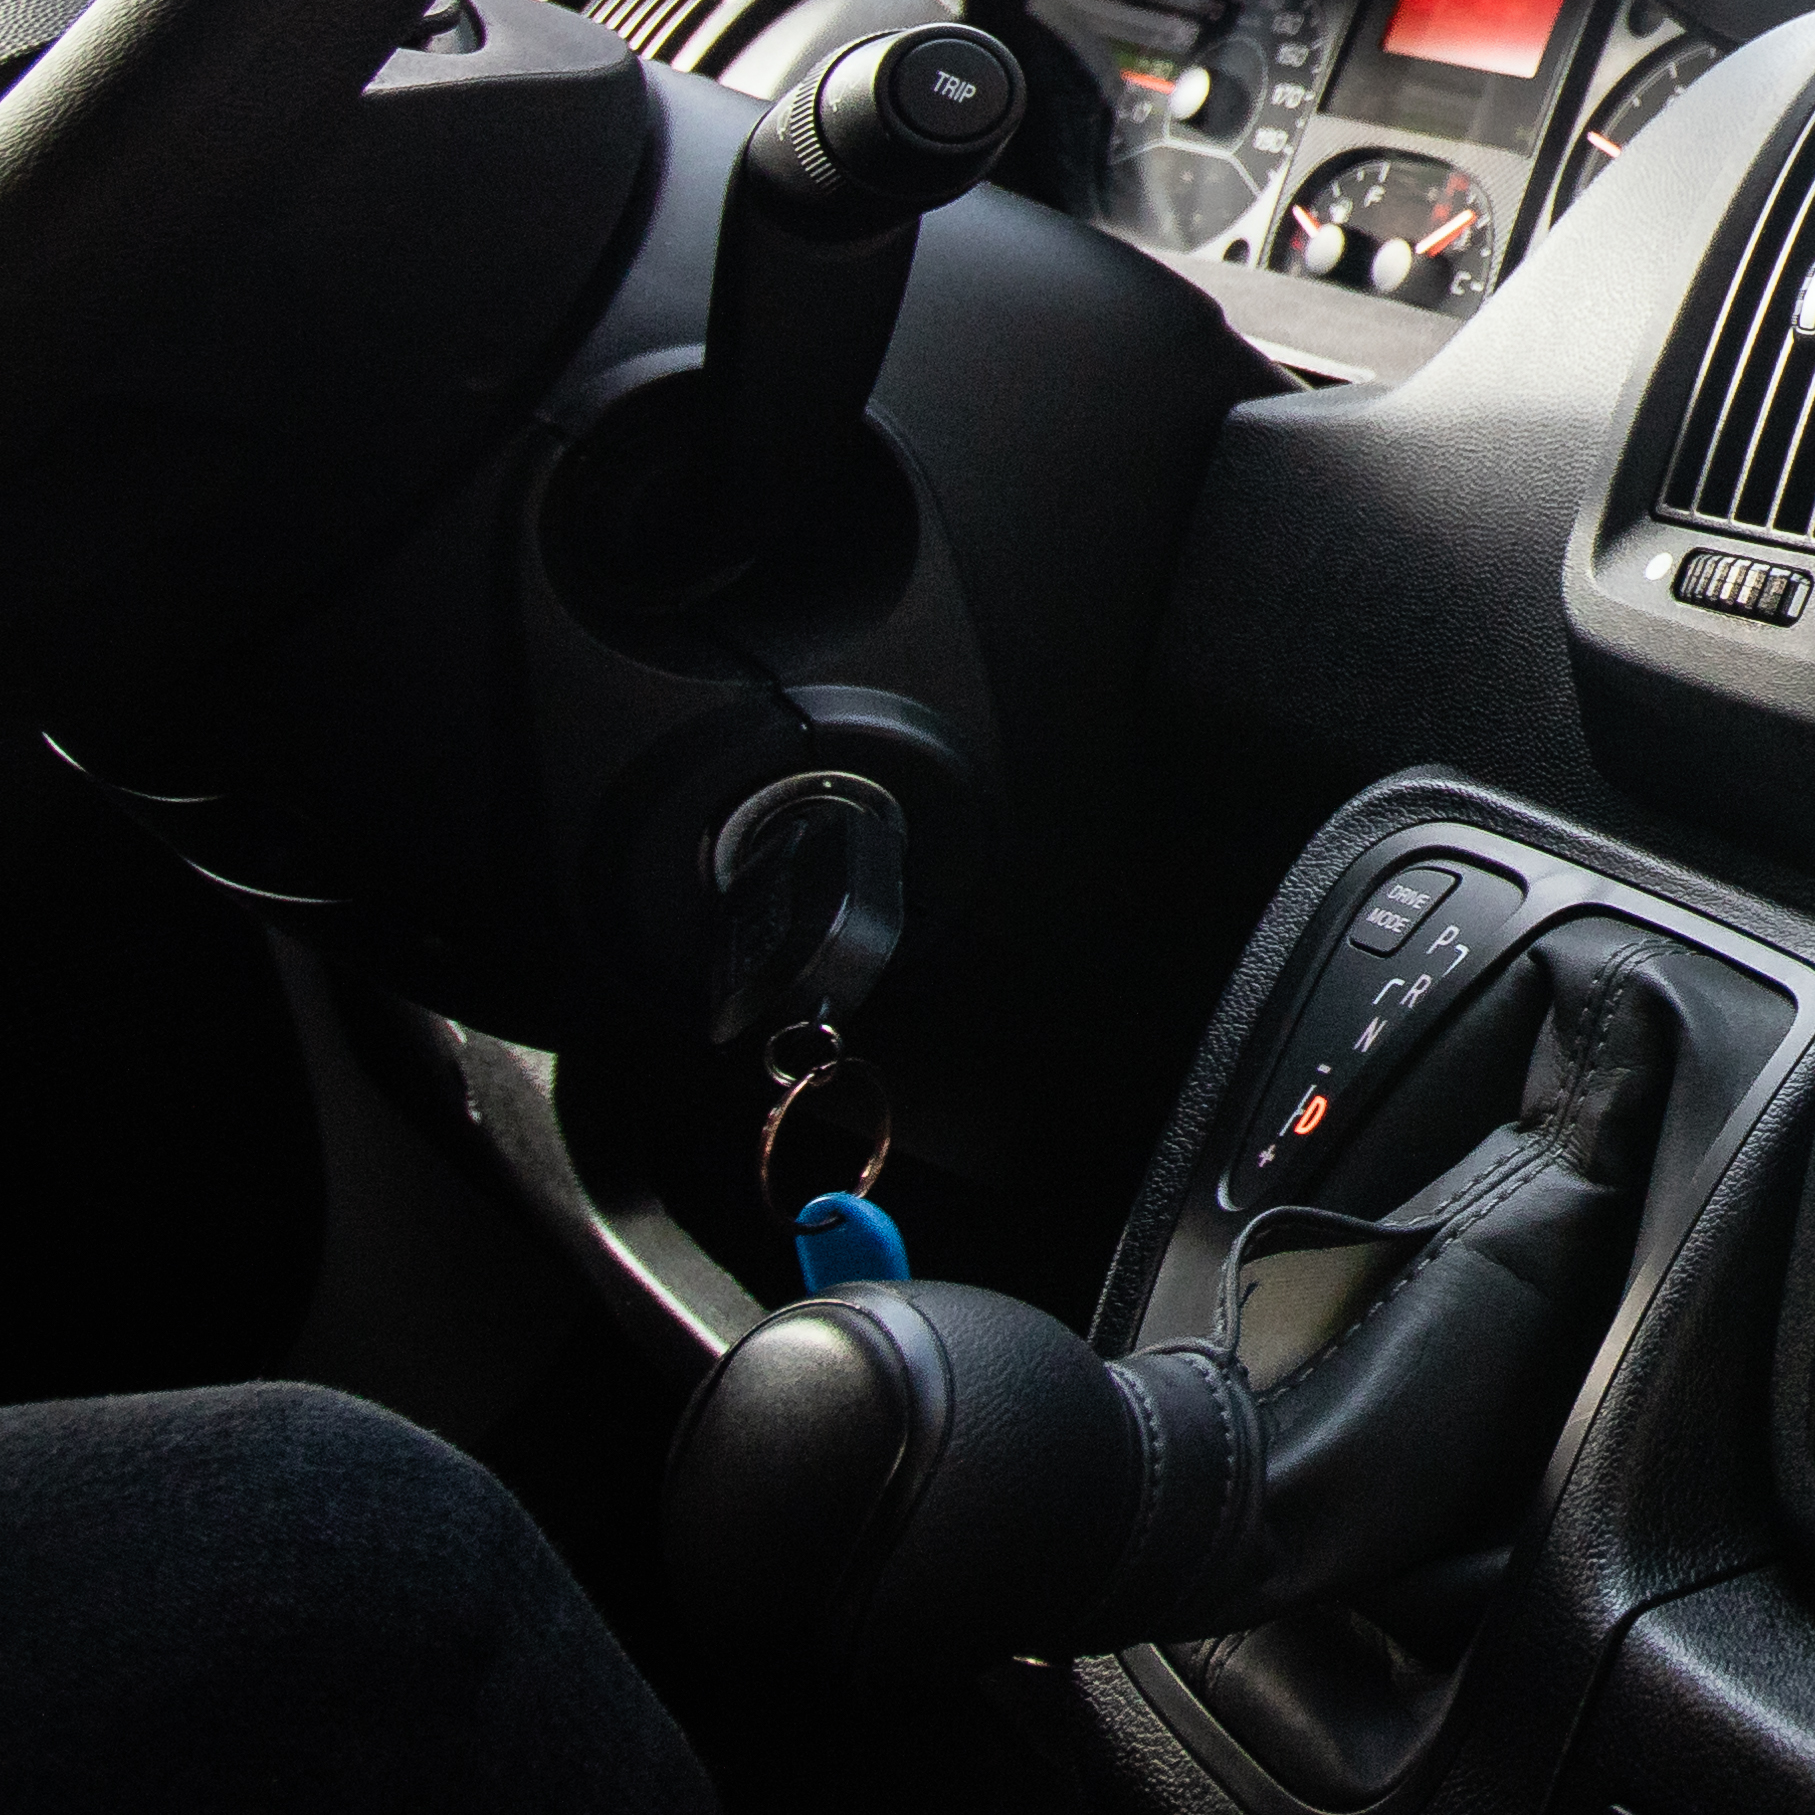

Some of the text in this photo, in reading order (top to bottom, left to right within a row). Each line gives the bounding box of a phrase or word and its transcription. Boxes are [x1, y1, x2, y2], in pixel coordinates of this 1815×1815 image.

[934, 69, 977, 103] TRIP
[1386, 884, 1432, 911] DRIVE
[1365, 907, 1411, 934] MODE
[1426, 925, 1460, 956] P
[1401, 973, 1432, 1009] R
[1354, 1016, 1388, 1053] N
[1293, 1095, 1329, 1136] D
